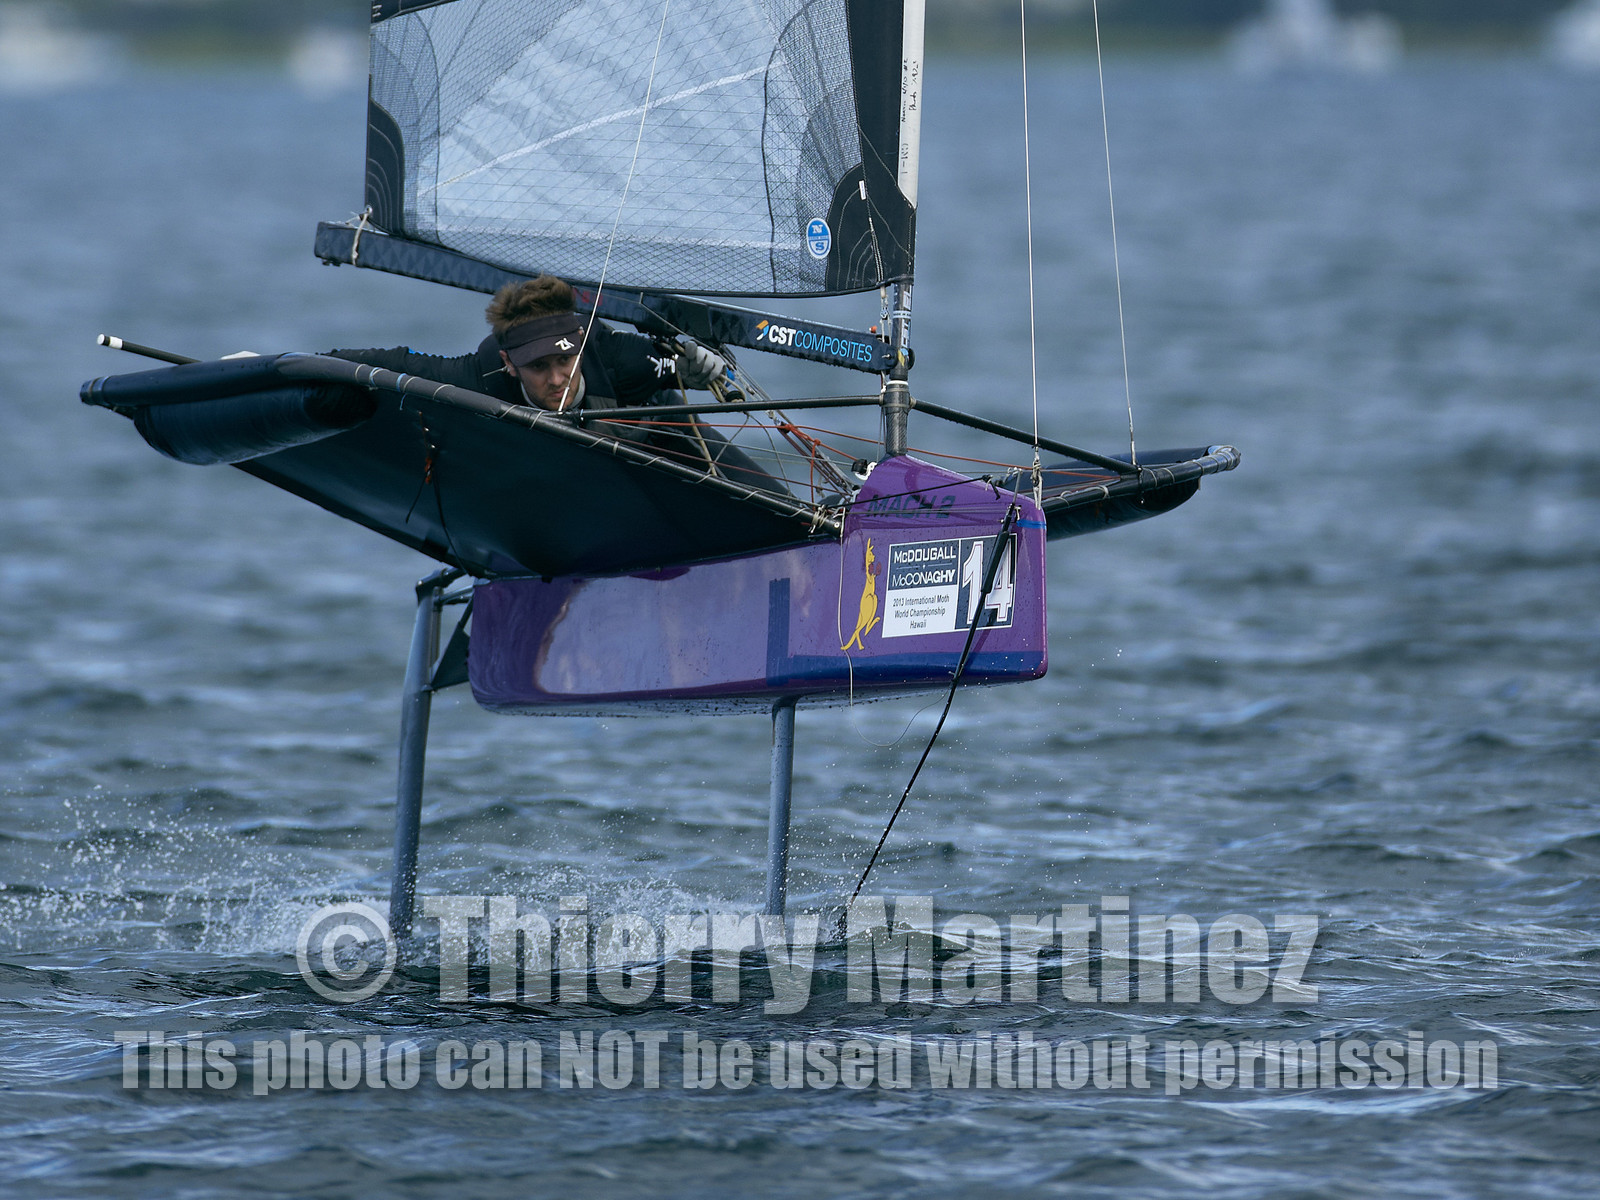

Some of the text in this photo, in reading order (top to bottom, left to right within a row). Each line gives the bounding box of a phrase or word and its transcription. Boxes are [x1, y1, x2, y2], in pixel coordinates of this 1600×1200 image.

[962, 538, 1013, 625] 14
[905, 595, 936, 606] International
[937, 594, 950, 603] Moth
[894, 606, 946, 618] World Championship
